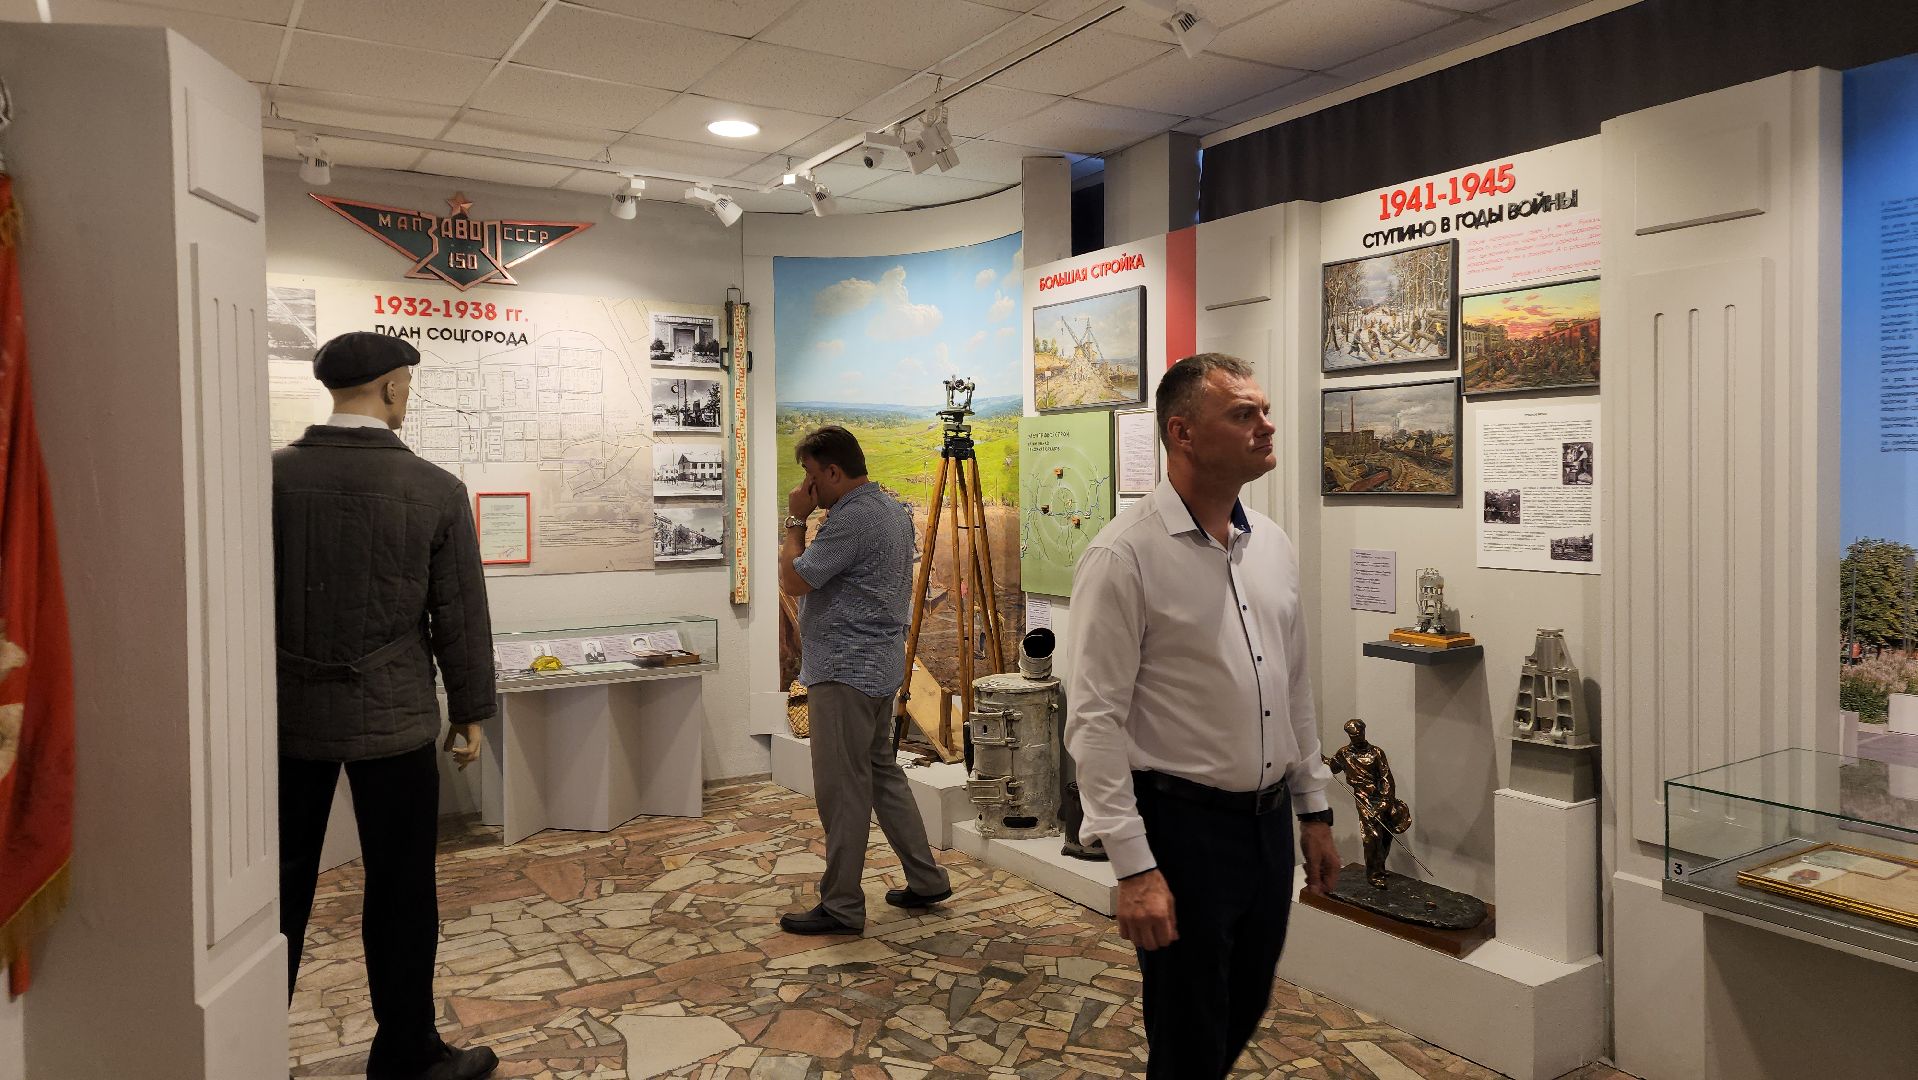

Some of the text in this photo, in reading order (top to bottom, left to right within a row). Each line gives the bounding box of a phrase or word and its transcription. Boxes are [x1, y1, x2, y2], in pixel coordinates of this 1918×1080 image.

[1379, 163, 1516, 220] 1941-1945
[378, 212, 423, 232] МАП
[503, 227, 549, 244] СССР
[1362, 220, 1437, 249] СТУПИНО
[1441, 216, 1451, 233] В
[1455, 204, 1504, 230] ГОДЫ
[1507, 188, 1579, 220] ВОЙНЫ
[448, 252, 478, 270] 150
[1039, 252, 1146, 291] БОЛЬШАЯ СТРОЙКА
[374, 294, 498, 321] 1932-1938
[375, 324, 529, 346] ПЛАН СОЦГОРОДА
[1673, 862, 1683, 876] 3
